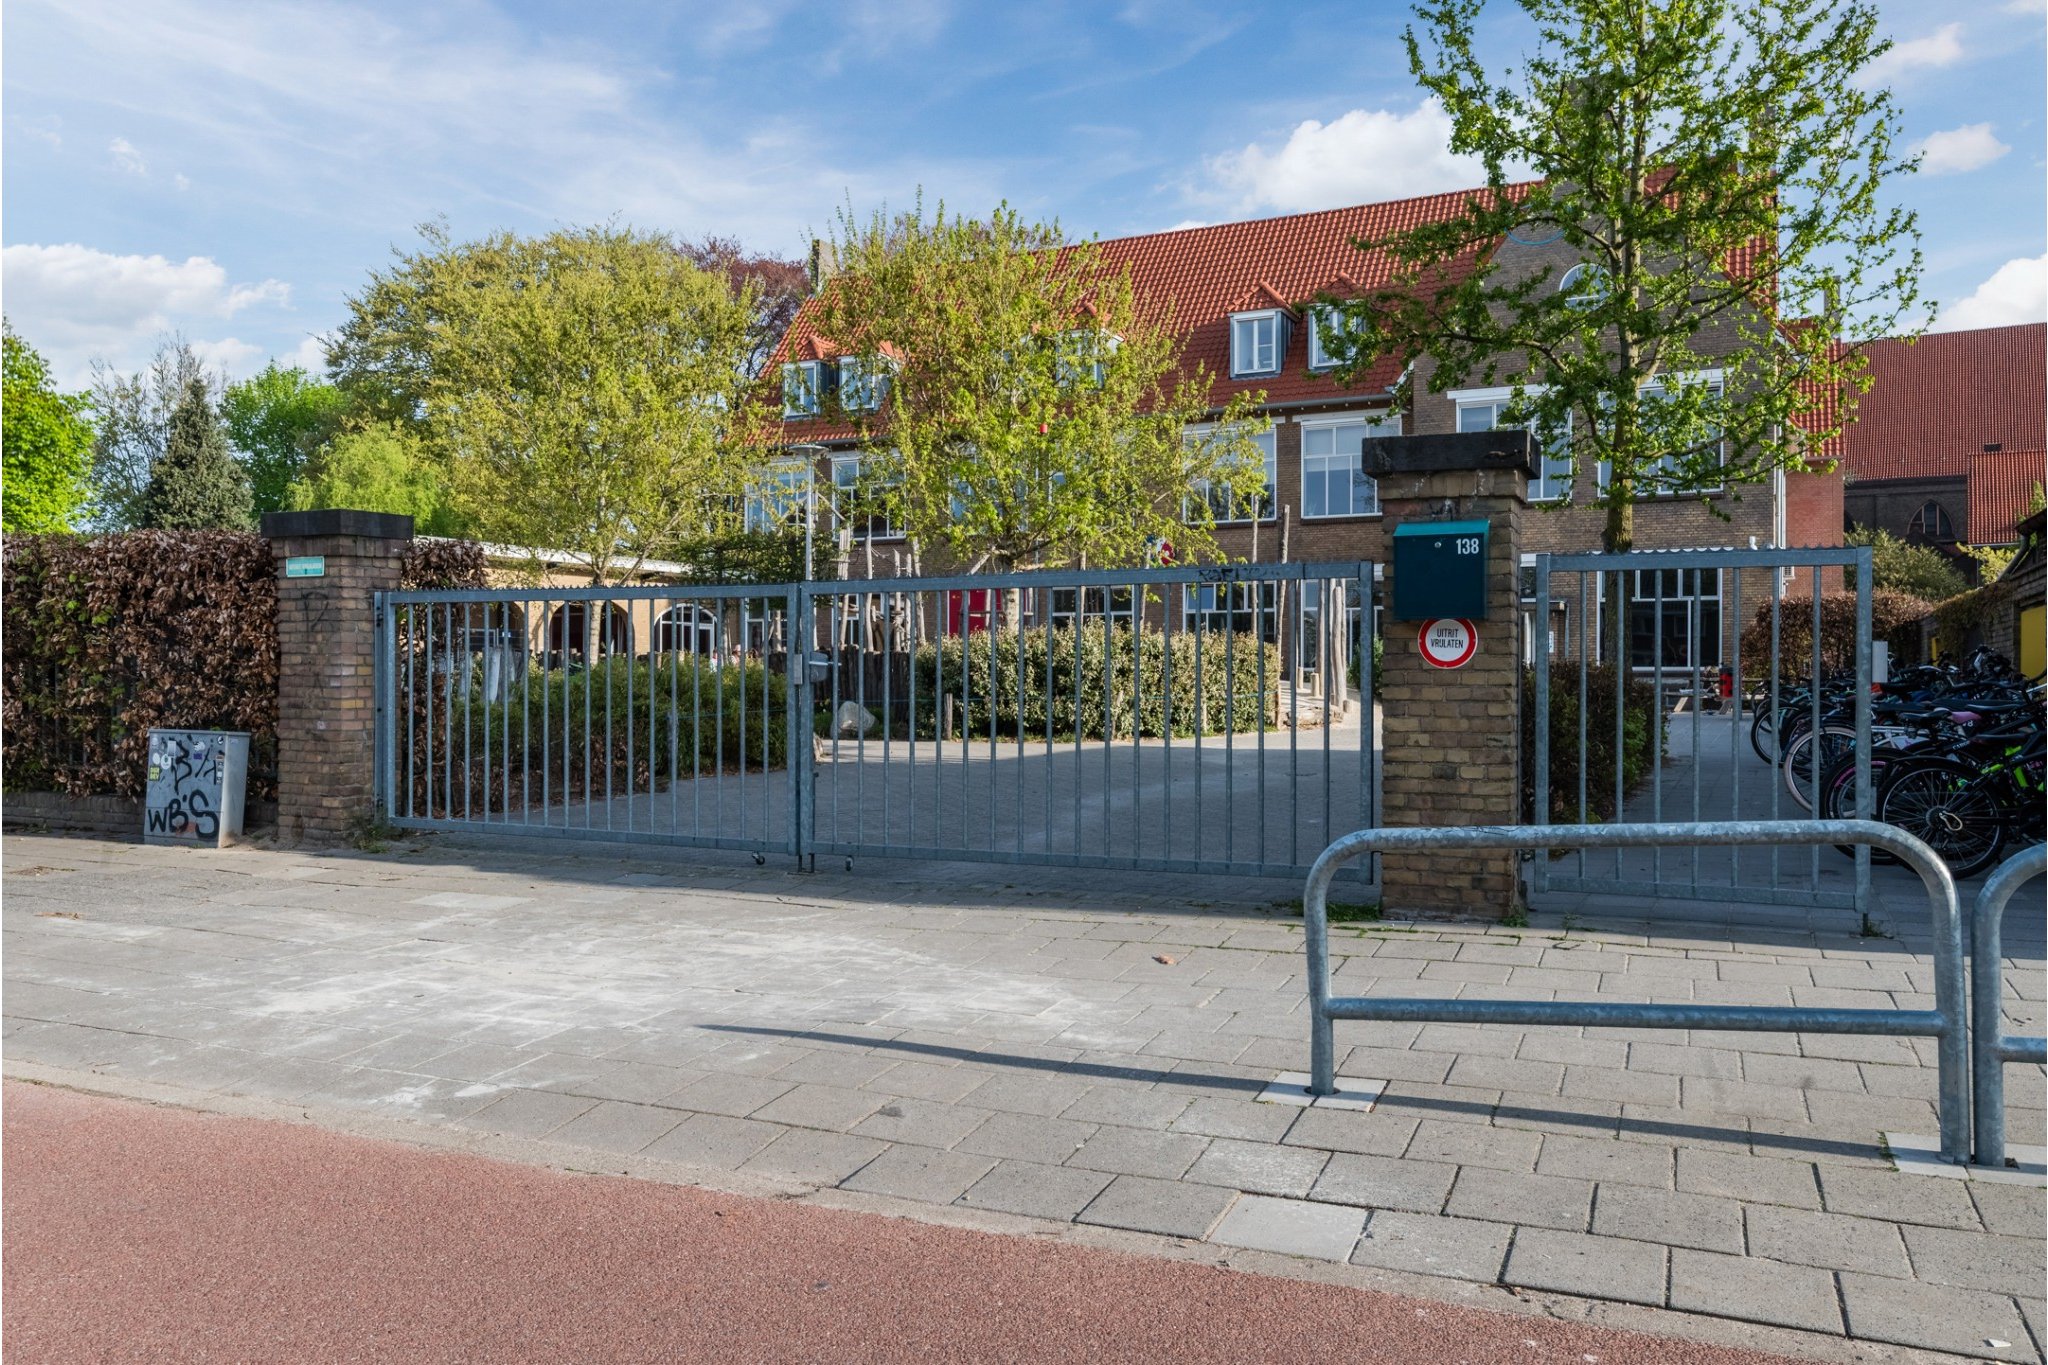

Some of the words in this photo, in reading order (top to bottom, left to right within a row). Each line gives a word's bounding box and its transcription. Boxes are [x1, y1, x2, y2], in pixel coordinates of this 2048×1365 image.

[1455, 538, 1479, 555] 138
[1436, 628, 1459, 638] UITRIT
[1430, 638, 1464, 649] VRIJLATEN
